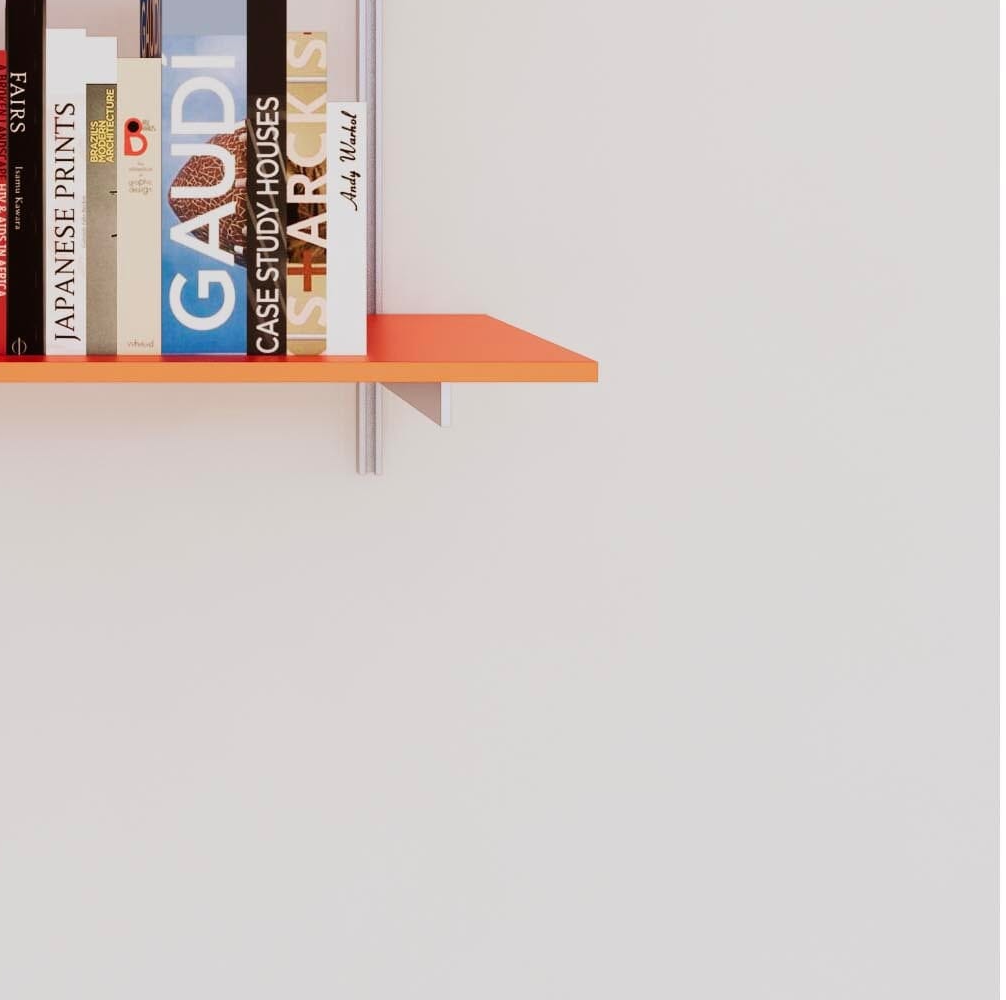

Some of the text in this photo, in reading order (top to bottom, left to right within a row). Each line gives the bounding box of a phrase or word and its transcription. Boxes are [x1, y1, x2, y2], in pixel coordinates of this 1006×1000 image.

[10, 72, 26, 133] FAIRS
[98, 119, 106, 163] MODERN
[106, 88, 114, 163] ARCHITECTURE
[15, 166, 23, 230] Isamu Kawara
[162, 52, 236, 331] GAUDÍ
[339, 110, 361, 212] Andy Warhol
[55, 103, 81, 341] JAPANESE PRINTS
[256, 96, 280, 354] CASE STUDY HOUSES
